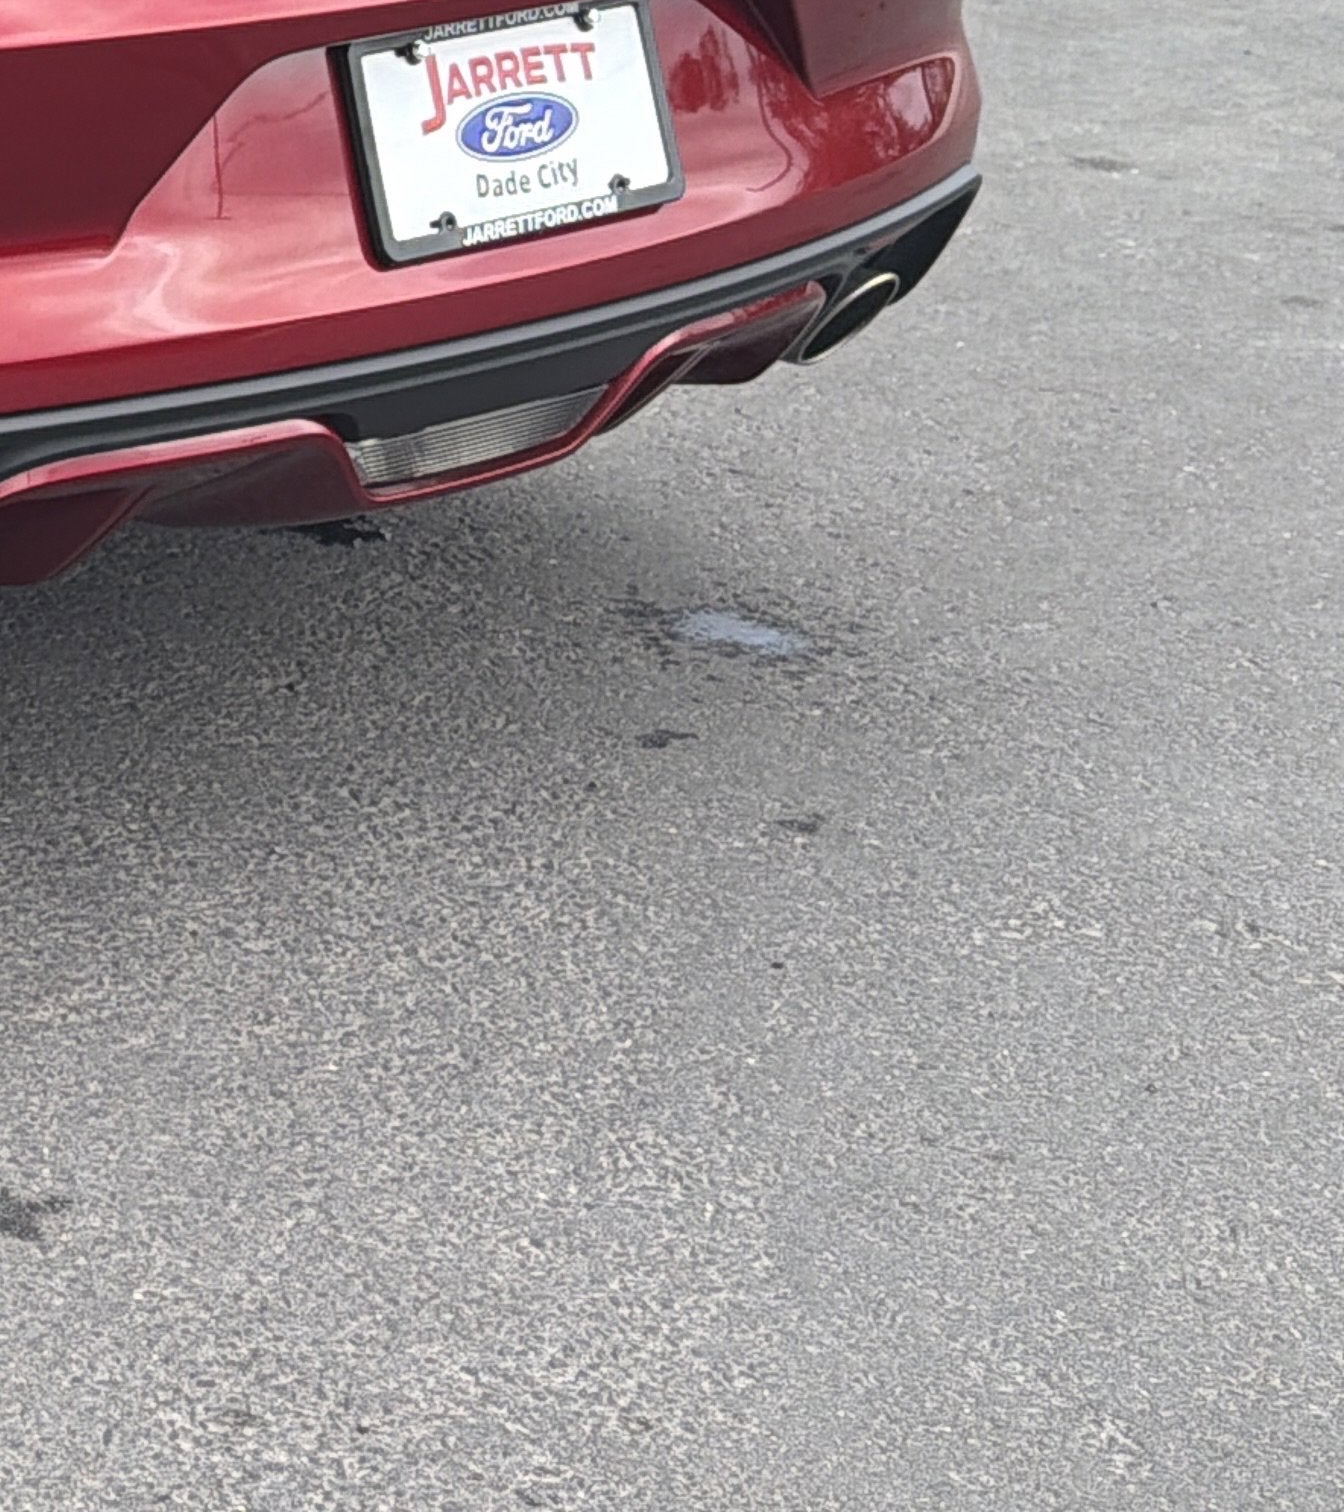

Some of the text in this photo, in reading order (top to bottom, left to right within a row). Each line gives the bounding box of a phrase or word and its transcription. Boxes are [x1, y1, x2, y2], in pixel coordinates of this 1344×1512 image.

[421, 42, 595, 135] JARRETT
[480, 100, 554, 153] Ford
[476, 159, 579, 198] Dade City
[462, 195, 618, 246] JARRETTFORD.COM
